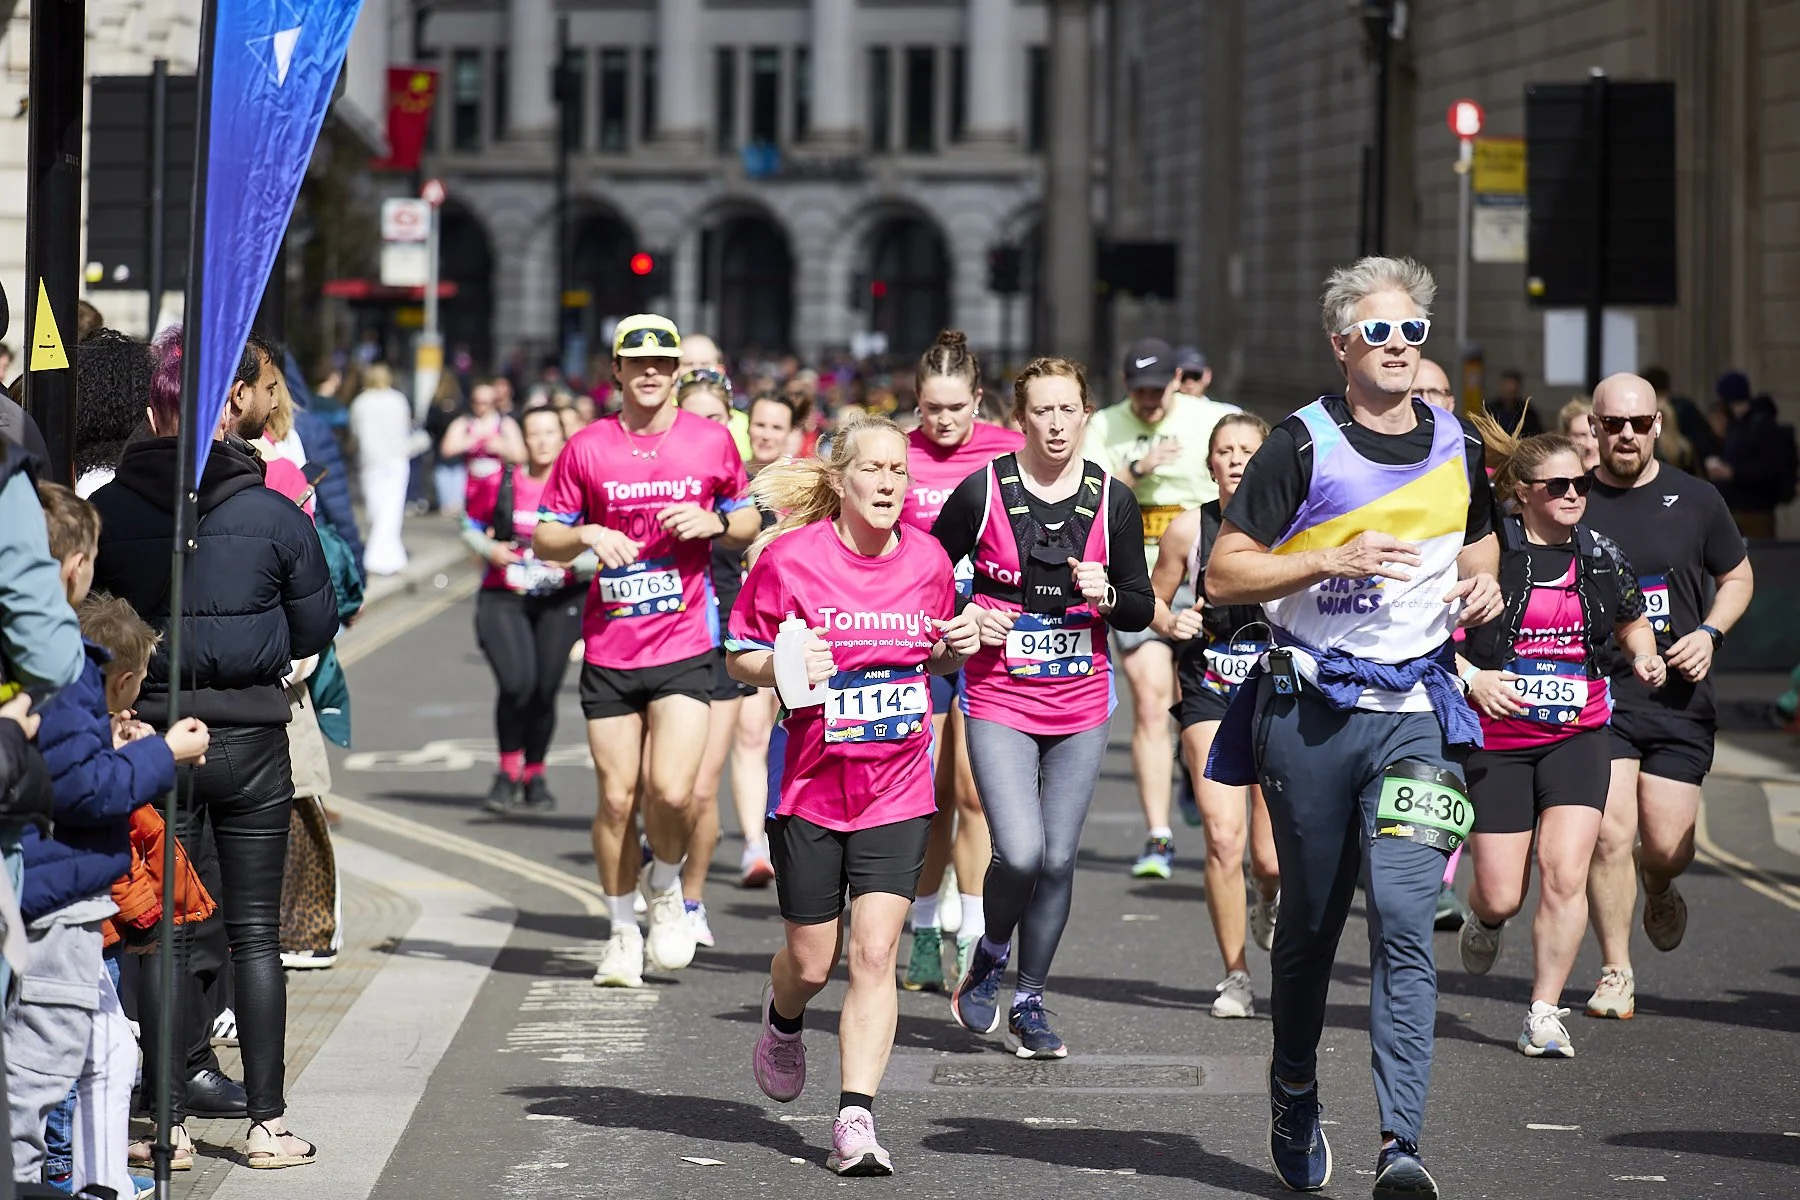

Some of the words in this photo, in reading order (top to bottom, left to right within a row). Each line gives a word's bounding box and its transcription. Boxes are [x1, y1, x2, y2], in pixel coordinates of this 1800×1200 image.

[602, 476, 702, 500] Tommy's
[607, 573, 675, 599] 10763
[1035, 585, 1062, 596] TIYA
[1316, 593, 1382, 615] WINGS
[818, 607, 932, 637] Tommy's
[1042, 617, 1063, 626] KATE
[835, 638, 878, 648] pregnancy
[879, 638, 894, 646] and
[895, 638, 914, 649] baby
[1021, 632, 1081, 654] 9437
[864, 670, 891, 680] ANNE
[1536, 662, 1557, 672] KATY
[1514, 677, 1575, 702] 9435
[1394, 786, 1465, 827] 8430
